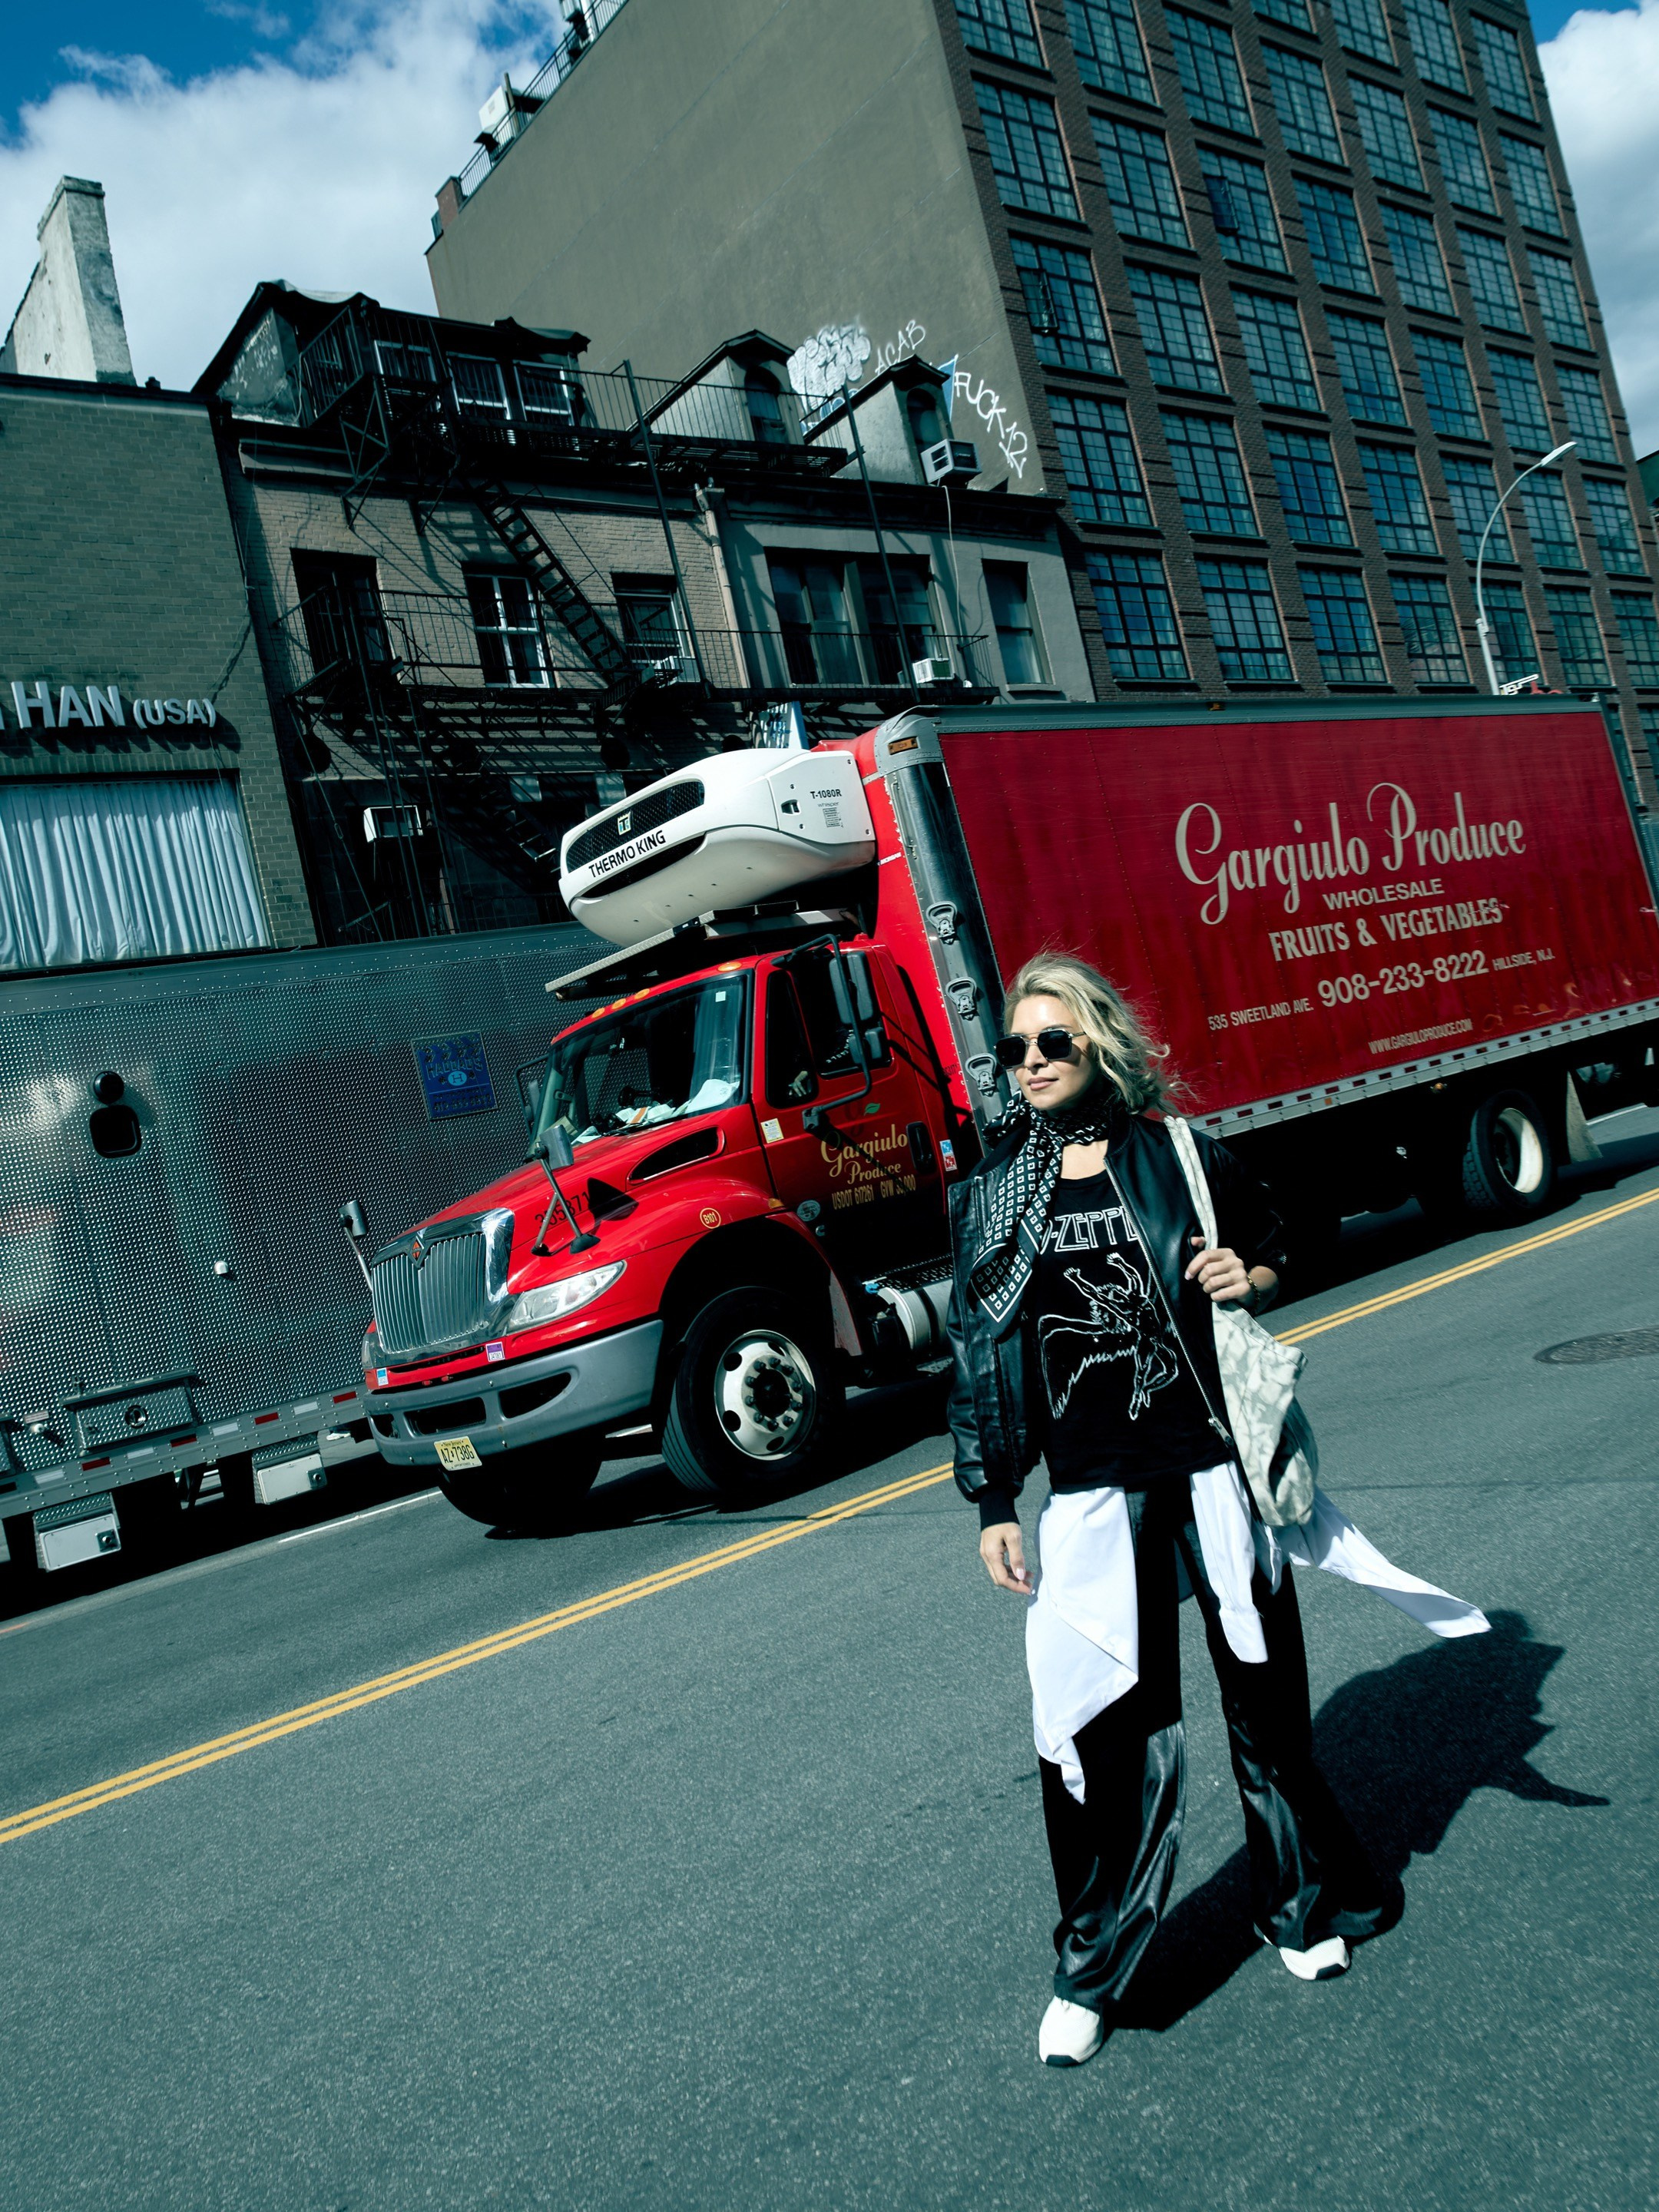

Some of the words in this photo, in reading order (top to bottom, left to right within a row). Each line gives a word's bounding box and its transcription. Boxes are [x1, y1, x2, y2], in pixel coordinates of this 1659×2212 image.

[875, 320, 926, 376] ACAB
[955, 372, 1007, 439] FUCK
[11, 681, 125, 729] HAN
[133, 697, 217, 729] (USA)
[810, 789, 842, 799] T-1080R
[588, 846, 636, 878] THERMO
[635, 830, 667, 855] KING
[1175, 803, 1370, 926] Gargiulo
[1366, 783, 1526, 872] Produce
[1323, 878, 1445, 911] WHOLESALE
[1268, 922, 1350, 962] FRUITS
[1357, 918, 1377, 948] &
[1379, 897, 1503, 942] VEGETABLES
[1317, 949, 1490, 1008] 908-233-8222
[1208, 1013, 1229, 1031] 535
[1230, 1001, 1291, 1026] SWEETLAND
[1293, 998, 1314, 1014] AVE.
[820, 1124, 909, 1177] Gargiulo
[844, 1161, 902, 1184] Produce
[832, 1188, 853, 1210] USDOT
